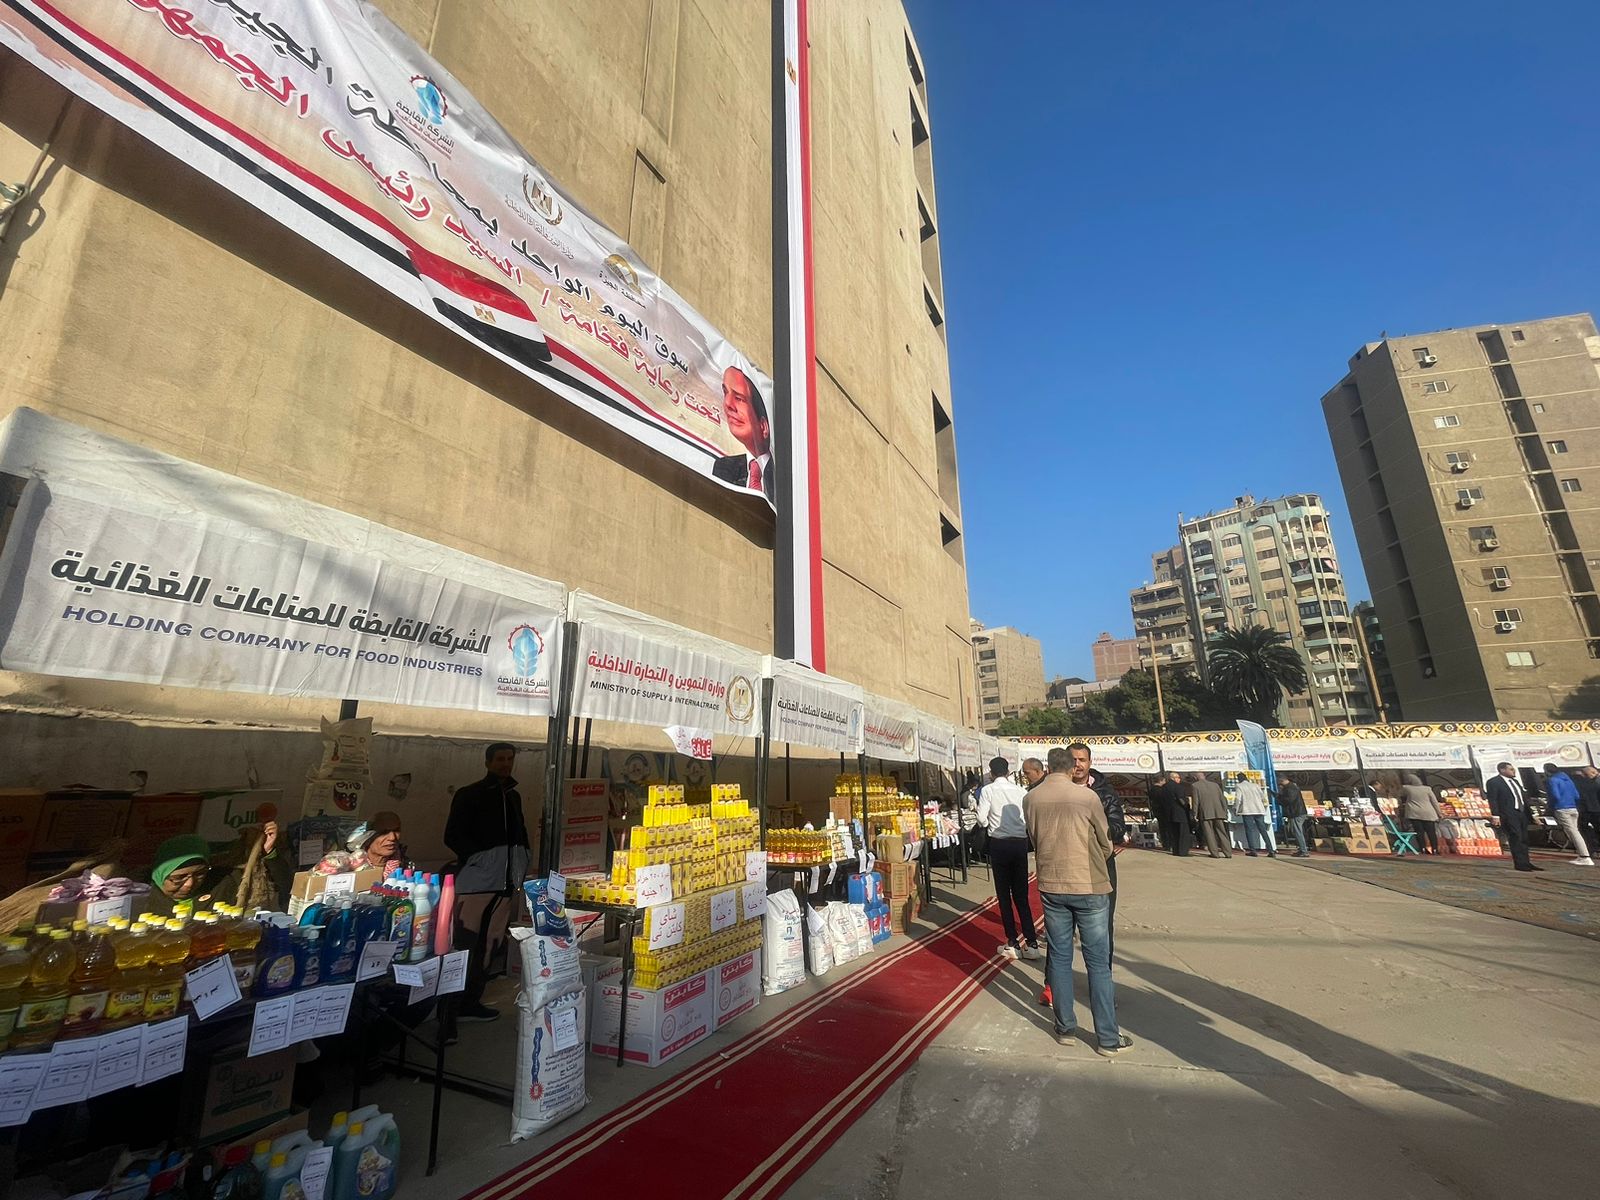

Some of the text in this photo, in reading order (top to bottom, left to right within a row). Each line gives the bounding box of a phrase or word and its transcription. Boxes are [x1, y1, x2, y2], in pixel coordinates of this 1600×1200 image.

[322, 129, 431, 218] رئيس
[445, 215, 522, 285] السيد
[512, 239, 591, 301] الواحد
[560, 298, 629, 358] فخامة
[600, 303, 649, 341] اليوم
[633, 346, 681, 405] رعاية
[655, 334, 689, 374] سوق
[684, 393, 721, 425] تحت
[51, 549, 492, 655] الشركة القابضة للصناعات الغذائية
[62, 605, 483, 677] HOLDING COMPANY FOR FOOD INDUSTRIES
[497, 675, 550, 689] الشركة القابضة
[588, 651, 726, 698] وزارة التموين و التجارة الداخلية
[590, 681, 630, 695] MINISTRY
[630, 688, 641, 697] OF
[642, 690, 668, 702] SUPPLY
[692, 743, 711, 757] SALE
[665, 978, 706, 1003] كابتن
